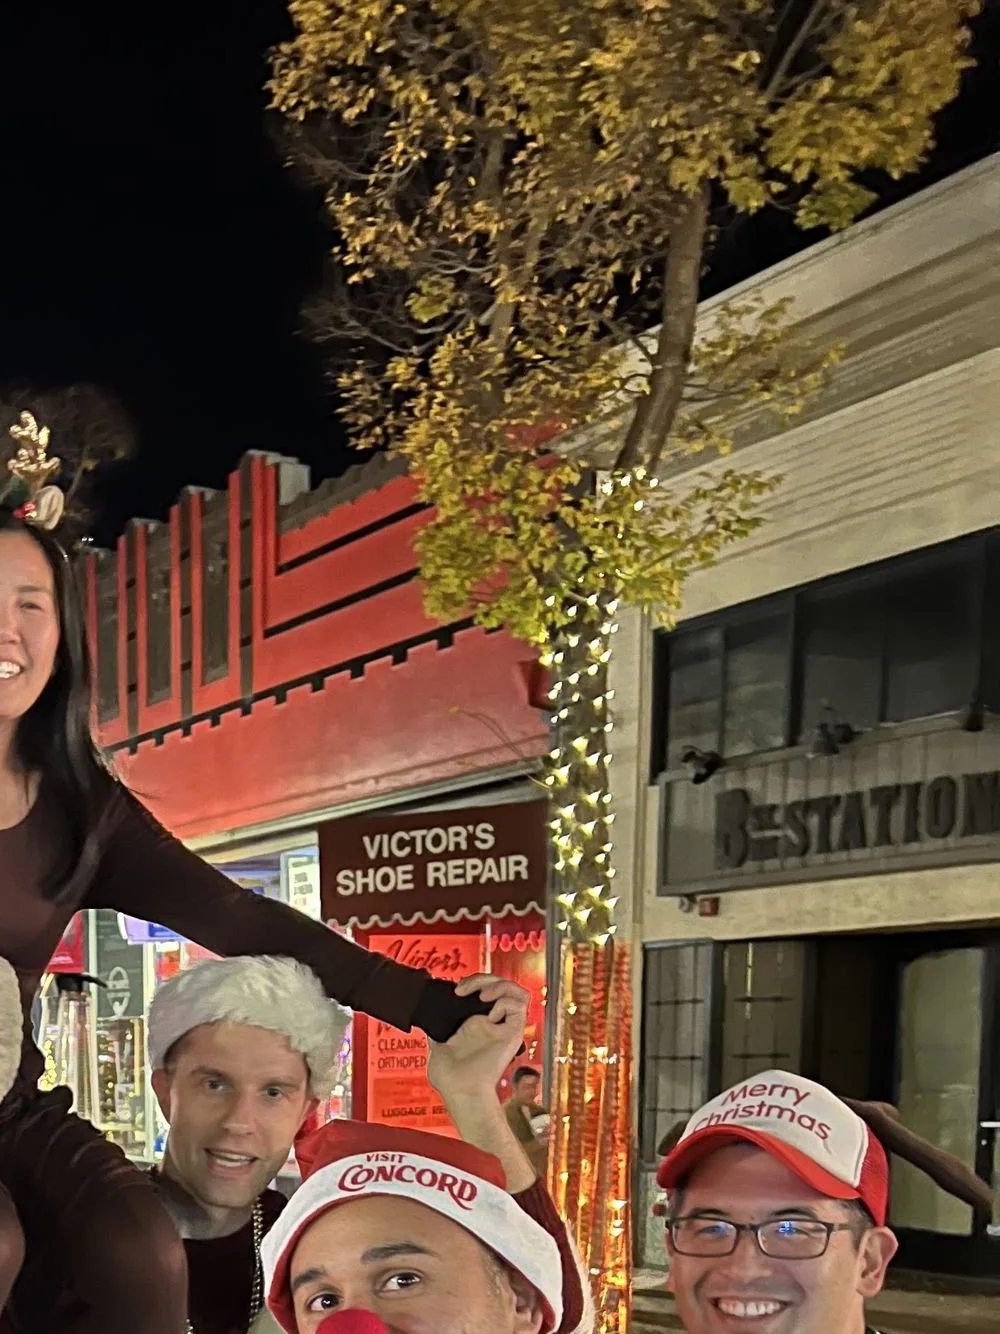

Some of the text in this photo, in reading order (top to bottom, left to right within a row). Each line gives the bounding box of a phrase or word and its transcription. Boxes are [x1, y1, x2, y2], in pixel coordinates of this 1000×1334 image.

[362, 823, 495, 859] VICTOR'S
[336, 864, 414, 895] SHOE
[427, 854, 528, 887] REPAIR
[377, 1055, 427, 1069] ORTHOPED
[720, 1083, 811, 1106] Merry
[366, 1154, 405, 1163] VISIT
